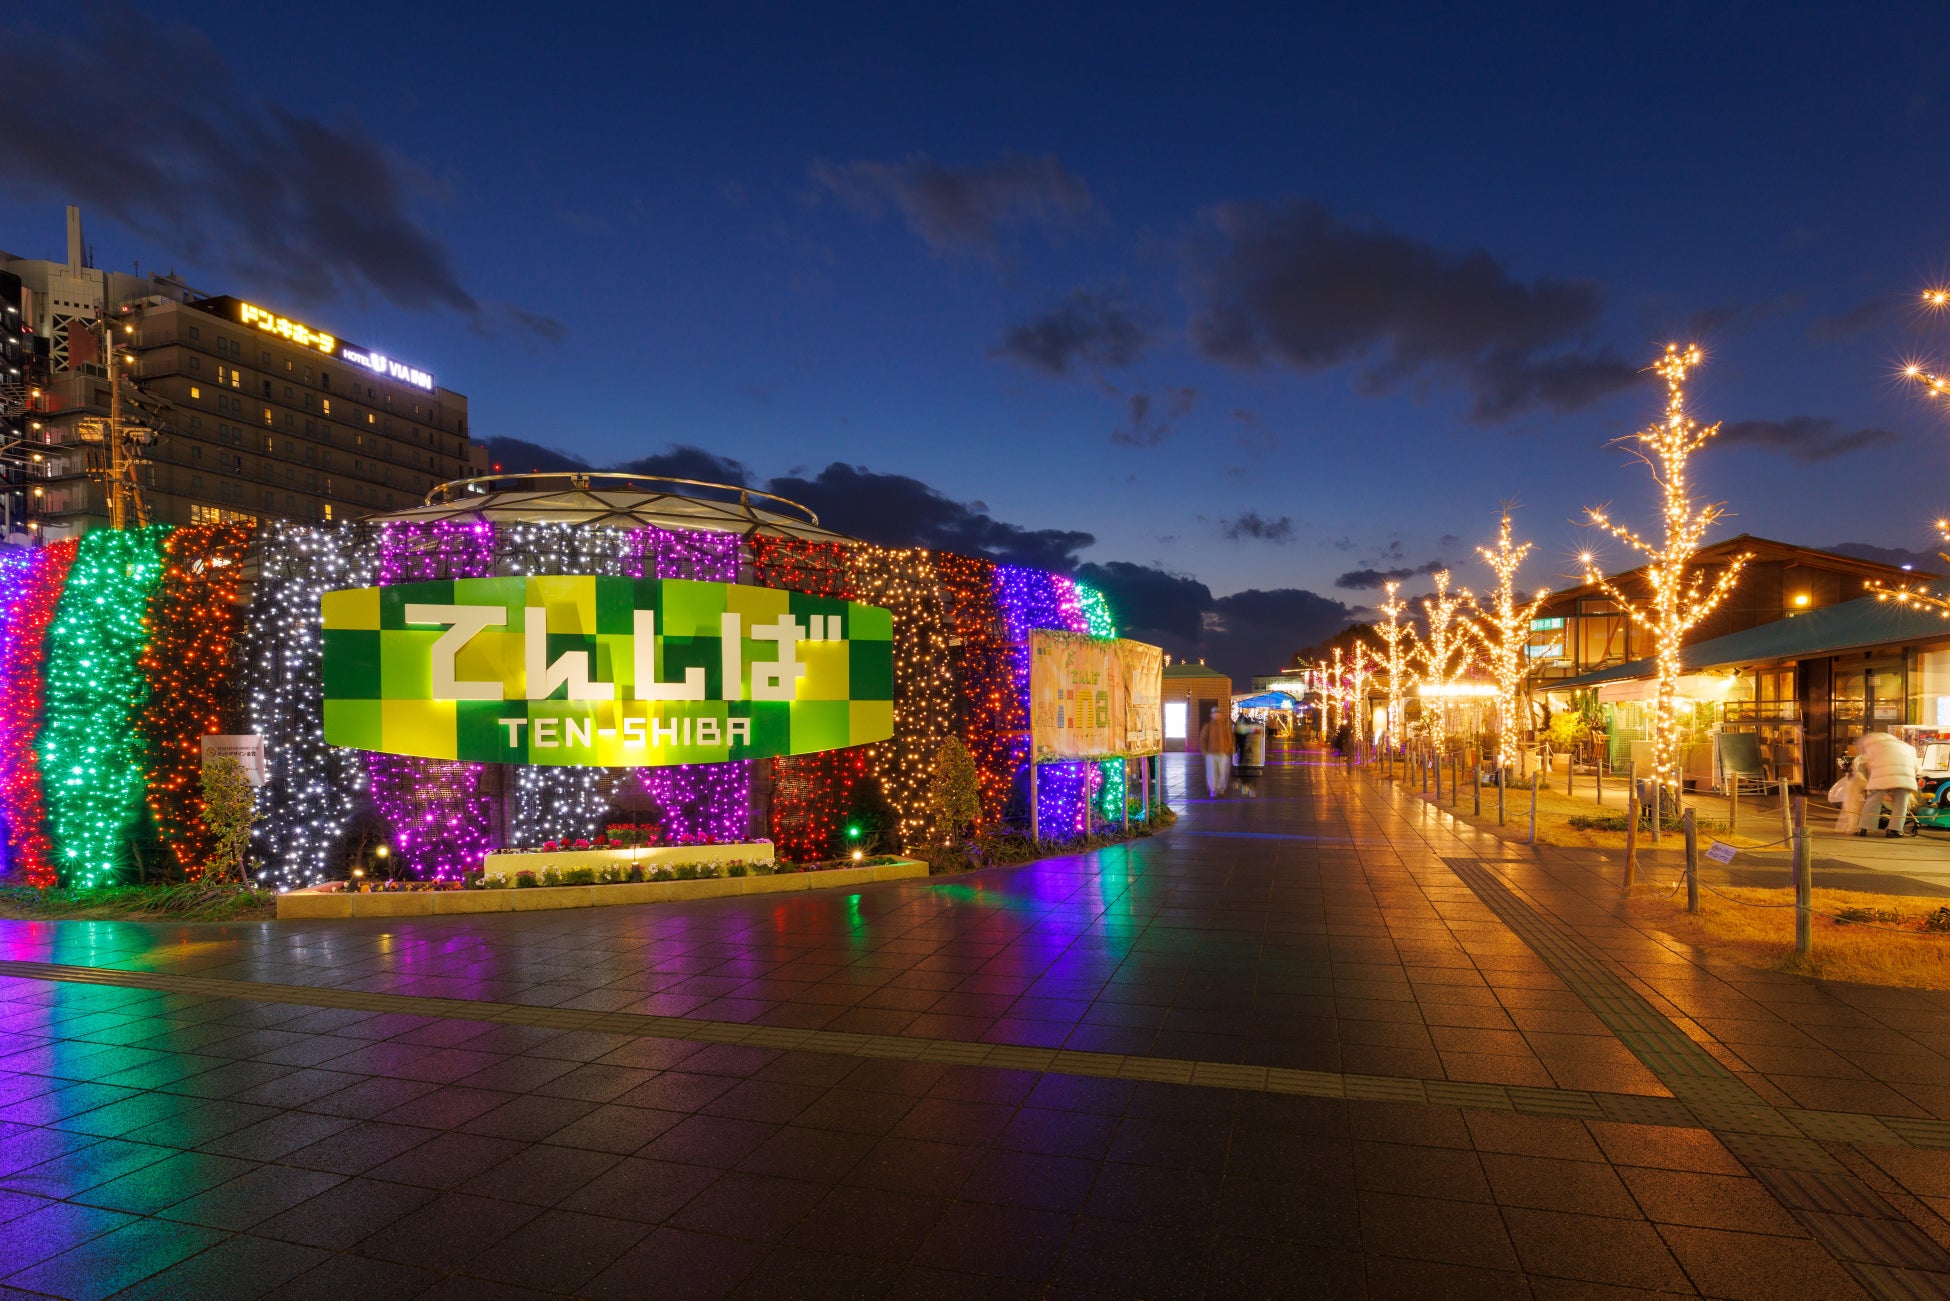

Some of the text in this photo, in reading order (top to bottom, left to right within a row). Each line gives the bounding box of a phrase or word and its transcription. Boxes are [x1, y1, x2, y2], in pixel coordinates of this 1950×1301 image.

[343, 349, 432, 390] HOTEL VIA INN
[405, 603, 842, 700] てんしば
[498, 717, 751, 747] TEN-SHIBA
